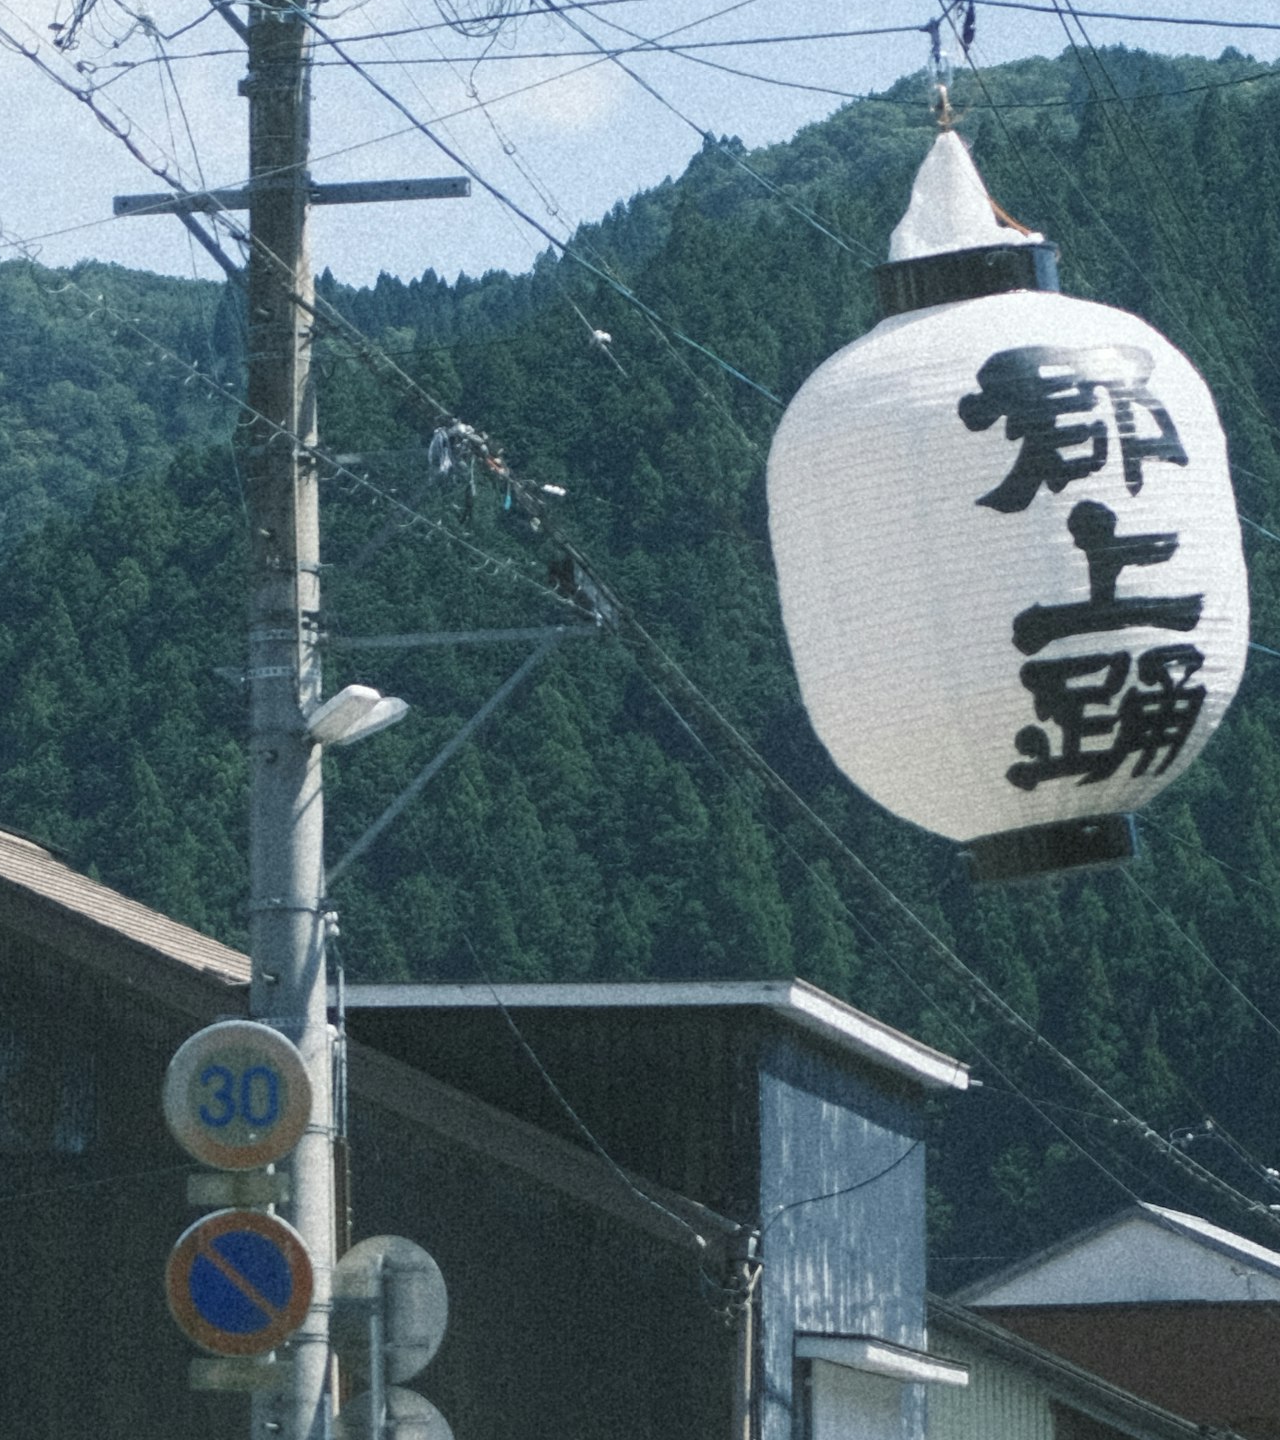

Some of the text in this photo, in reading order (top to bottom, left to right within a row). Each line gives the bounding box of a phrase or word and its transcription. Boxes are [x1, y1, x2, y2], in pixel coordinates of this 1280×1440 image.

[958, 344, 1207, 792] 郡上踊
[198, 1064, 281, 1129] 30
